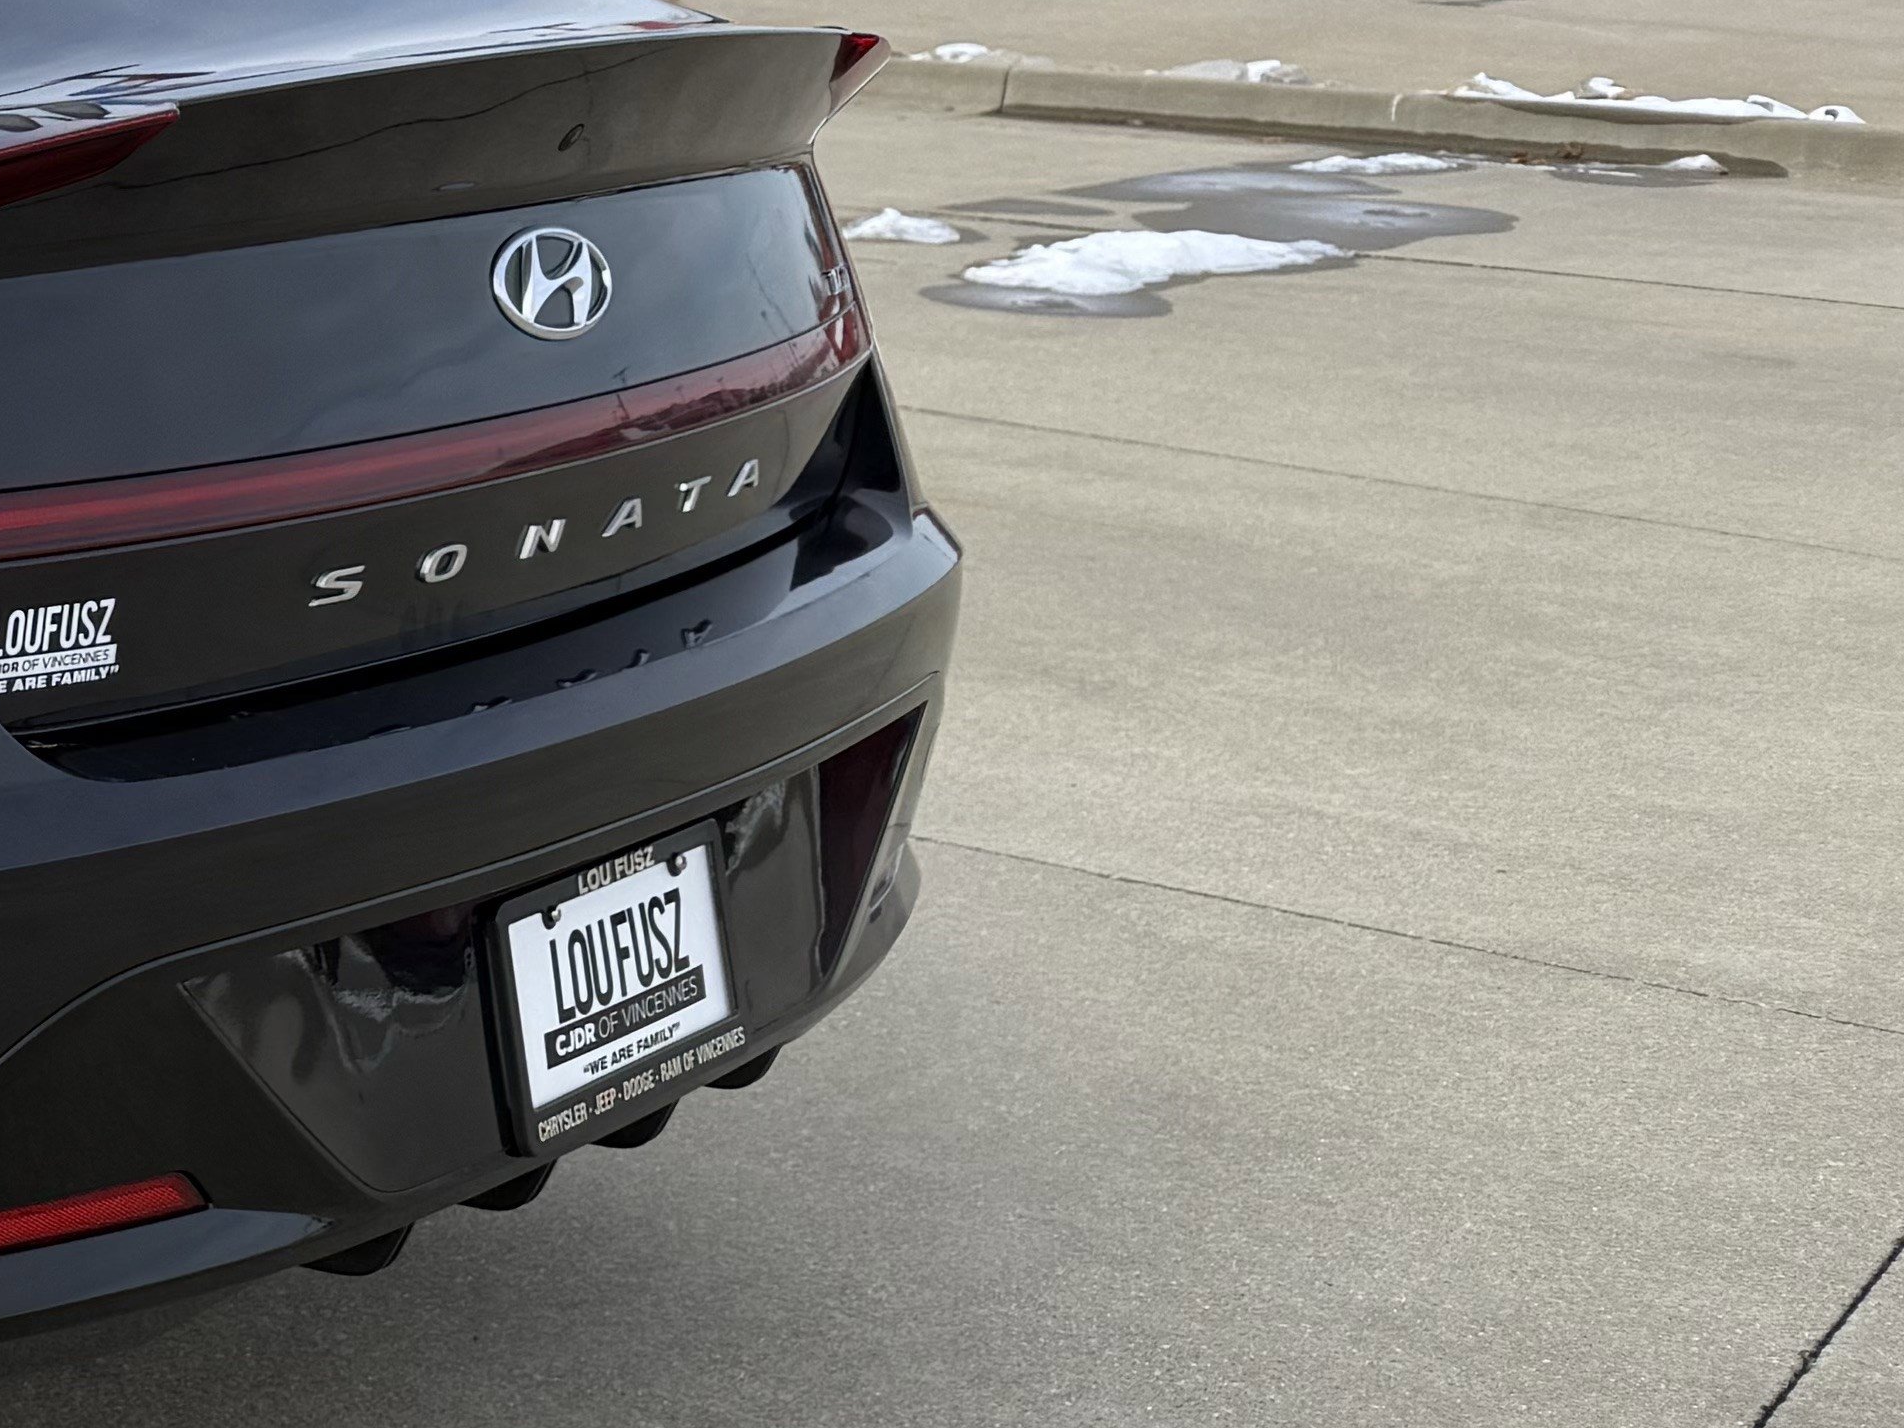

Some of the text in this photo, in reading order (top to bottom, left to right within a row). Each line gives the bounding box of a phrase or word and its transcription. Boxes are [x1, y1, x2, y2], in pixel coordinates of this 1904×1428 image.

[307, 458, 761, 608] SONATA
[11, 674, 48, 693] ARE
[21, 658, 40, 672] OF
[42, 648, 111, 670] VINCENNES
[577, 844, 656, 897] LOU FUSZ
[554, 975, 699, 1057] CJDR OF VINCENNES
[610, 1041, 636, 1069] ARE
[538, 1025, 747, 1143] CHRYSLER JEEP DODGE RAM OF VINCENNES
